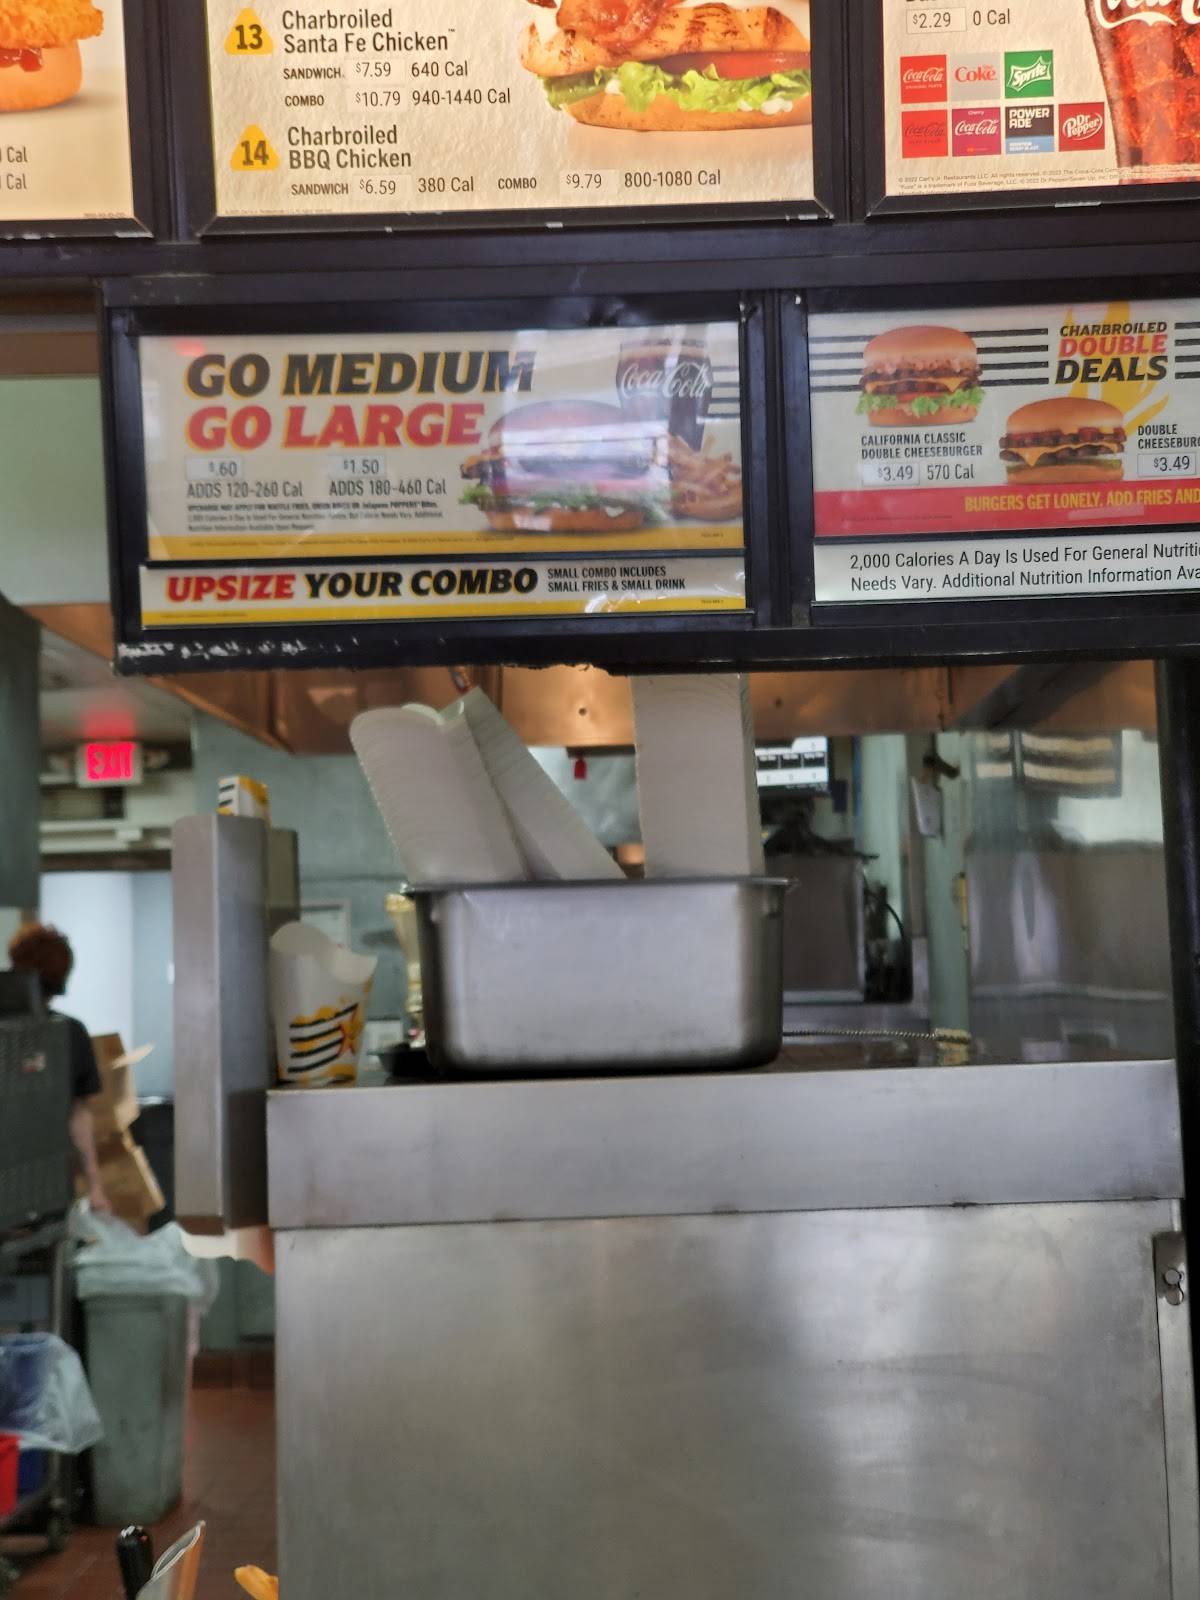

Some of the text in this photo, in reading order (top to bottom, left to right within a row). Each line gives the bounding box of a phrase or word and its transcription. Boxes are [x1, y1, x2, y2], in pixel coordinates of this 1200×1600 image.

[282, 9, 392, 30] Charbroiled
[912, 9, 1011, 29] $2.29 0 Cal
[235, 24, 263, 50] 13
[284, 34, 338, 53] Santa
[345, 33, 366, 52] Fe
[283, 61, 468, 80] SANDWICH $7.59 640 Cal
[955, 65, 997, 82] Coke
[1011, 63, 1047, 87] Sprite
[284, 88, 511, 107] COMBO $10.79 940-1440 Cal
[1009, 107, 1050, 119] POWER
[1076, 114, 1090, 123] Dr
[1009, 118, 1032, 129] ADE
[1065, 117, 1100, 138] Pepper
[287, 125, 398, 146] Charbroiled
[6, 146, 29, 163] Cal
[240, 140, 269, 166] 14
[289, 148, 412, 171] BBQ Chicken
[6, 173, 28, 190] Cal
[291, 169, 721, 196] SANDWICH $6.59 380 Cal COMBO $9.79 800-1080 Cal
[1060, 321, 1168, 336] CHARBROILED
[1060, 334, 1168, 357] DOUBLE
[186, 350, 537, 397] GO MEDIUM
[1055, 356, 1168, 384] DEALS
[620, 362, 712, 399] Coca-Cola
[186, 403, 485, 450] GO LARGE
[1138, 424, 1178, 436] DOUBLE
[861, 432, 966, 446] CALIFORNIA CLASSIC
[861, 445, 983, 460] DOUBLE CHEESEBURGER
[343, 459, 379, 475] $1.50
[878, 464, 913, 481] $3.49
[927, 463, 974, 480] 570 Cal
[1154, 455, 1190, 472] $3.49
[187, 480, 303, 498] ADDS 120-260 Cal
[329, 478, 447, 496] ADDS 180-460 Cal
[965, 494, 1025, 513] BURGERS
[1027, 493, 1050, 510] GET
[1136, 489, 1171, 506] FRIES
[1174, 488, 1200, 505] AND
[850, 542, 1200, 571] 2,000 Calories A Day Is Used For General Nutriti
[547, 566, 667, 579] SMALL COMBO INCLUDES
[851, 576, 897, 591] Needs
[901, 574, 936, 592] Vary.
[942, 571, 1015, 588] Additional
[1020, 569, 1083, 587] Nutrition
[1088, 566, 1172, 583] Information
[165, 567, 538, 601] UPSIZE YOUR COMBO
[548, 578, 686, 592] SMALL FRIES & SMALL DRINK
[86, 742, 135, 780] EXIT
